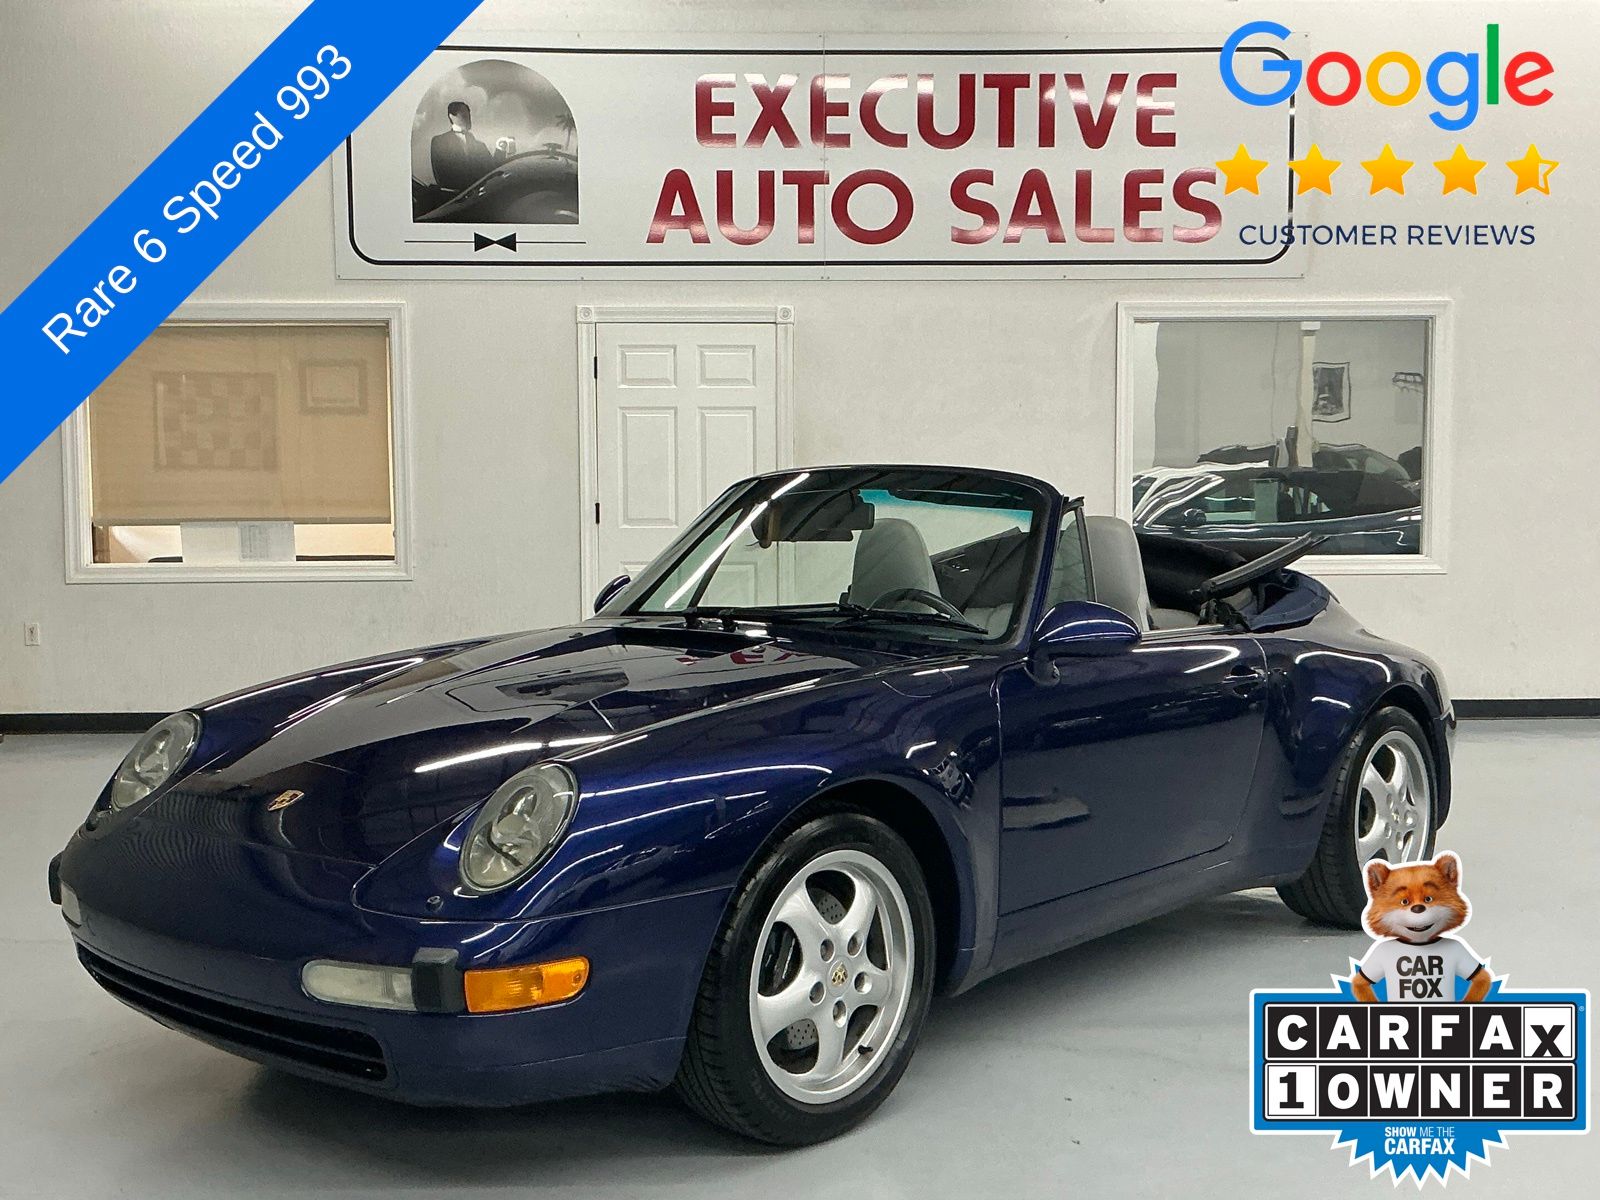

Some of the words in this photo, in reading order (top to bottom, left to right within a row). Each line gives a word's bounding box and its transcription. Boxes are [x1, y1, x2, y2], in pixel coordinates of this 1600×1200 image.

[695, 72, 1178, 150] EXECUTIVE
[647, 168, 915, 246] AUTO
[949, 168, 1222, 245] SALES
